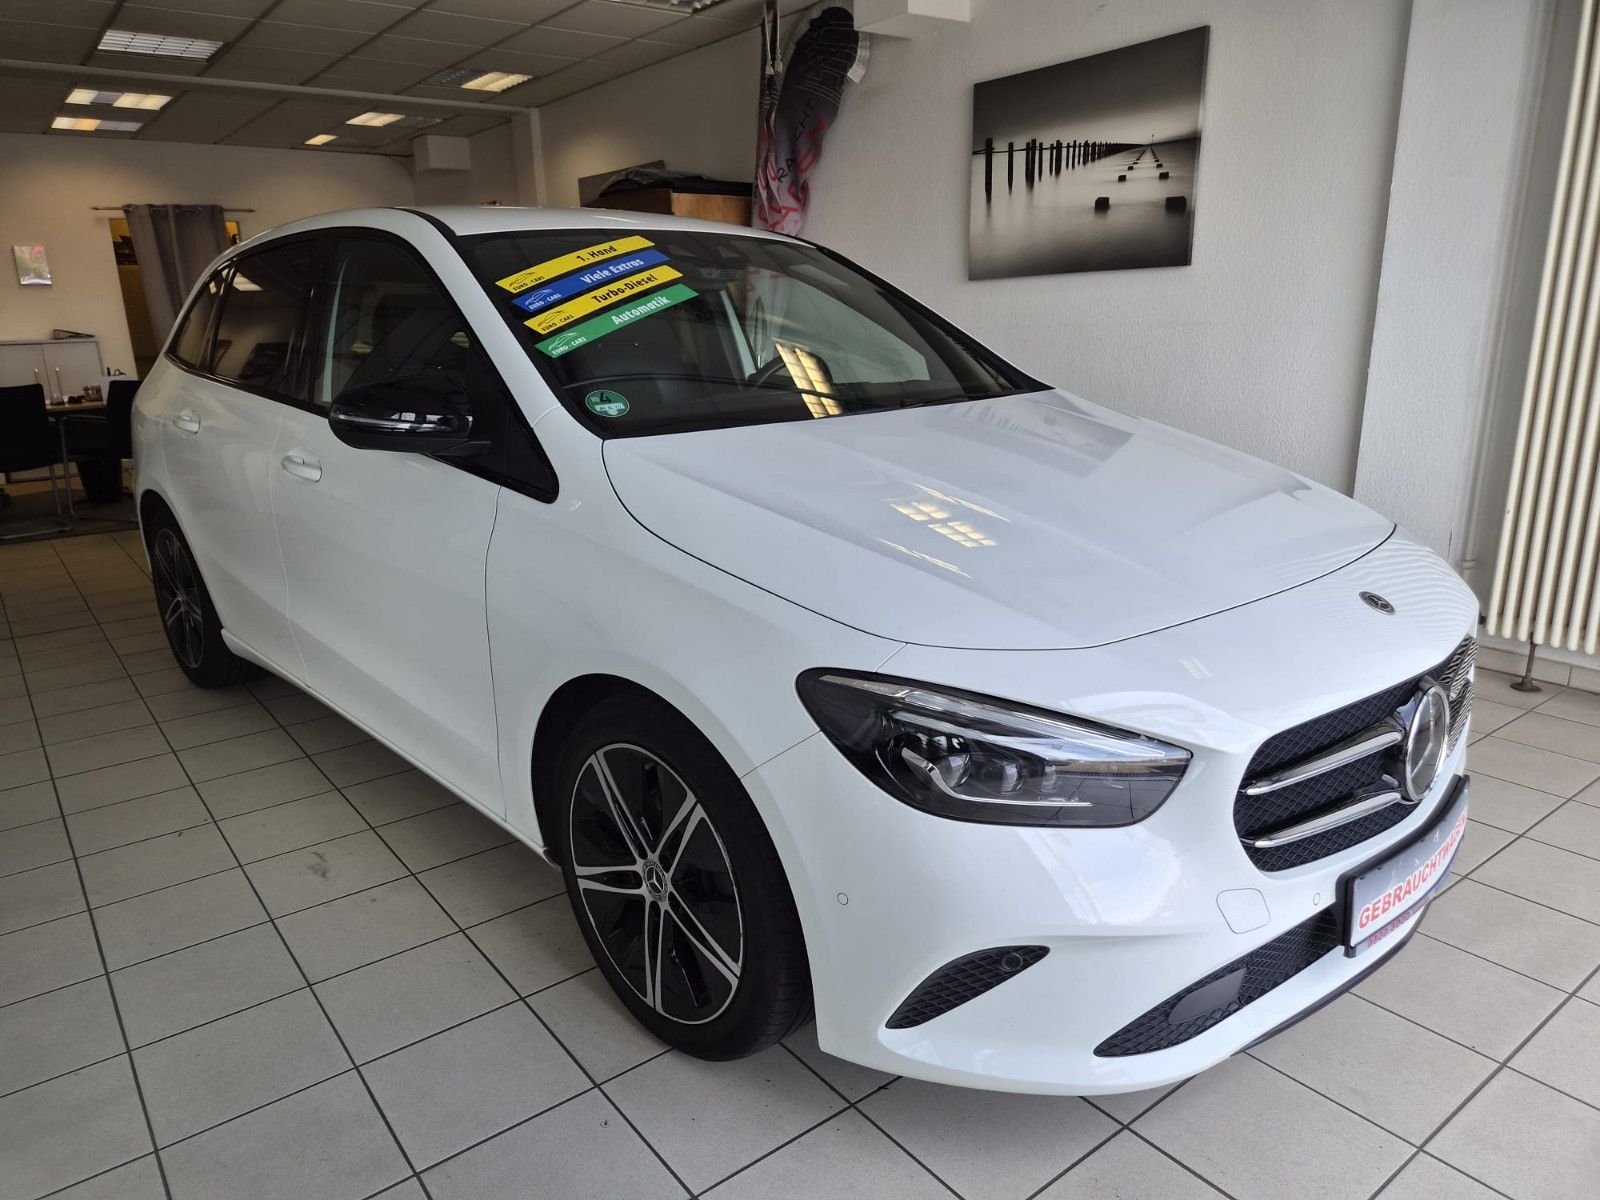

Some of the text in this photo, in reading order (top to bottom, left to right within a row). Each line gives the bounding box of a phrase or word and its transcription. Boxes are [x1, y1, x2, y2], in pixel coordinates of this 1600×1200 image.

[576, 245, 617, 263] 1. Hand
[580, 257, 645, 284] Viele Extras
[512, 282, 529, 292] EURO
[531, 275, 545, 285] CARS
[591, 274, 658, 304] Turbo-Diesel
[528, 301, 544, 310] EURO
[547, 293, 562, 302] CARS
[611, 295, 671, 326] Automatik
[541, 323, 557, 332] EURO
[560, 314, 575, 323] CARS
[552, 345, 568, 356] EURO
[571, 336, 587, 347] CARS
